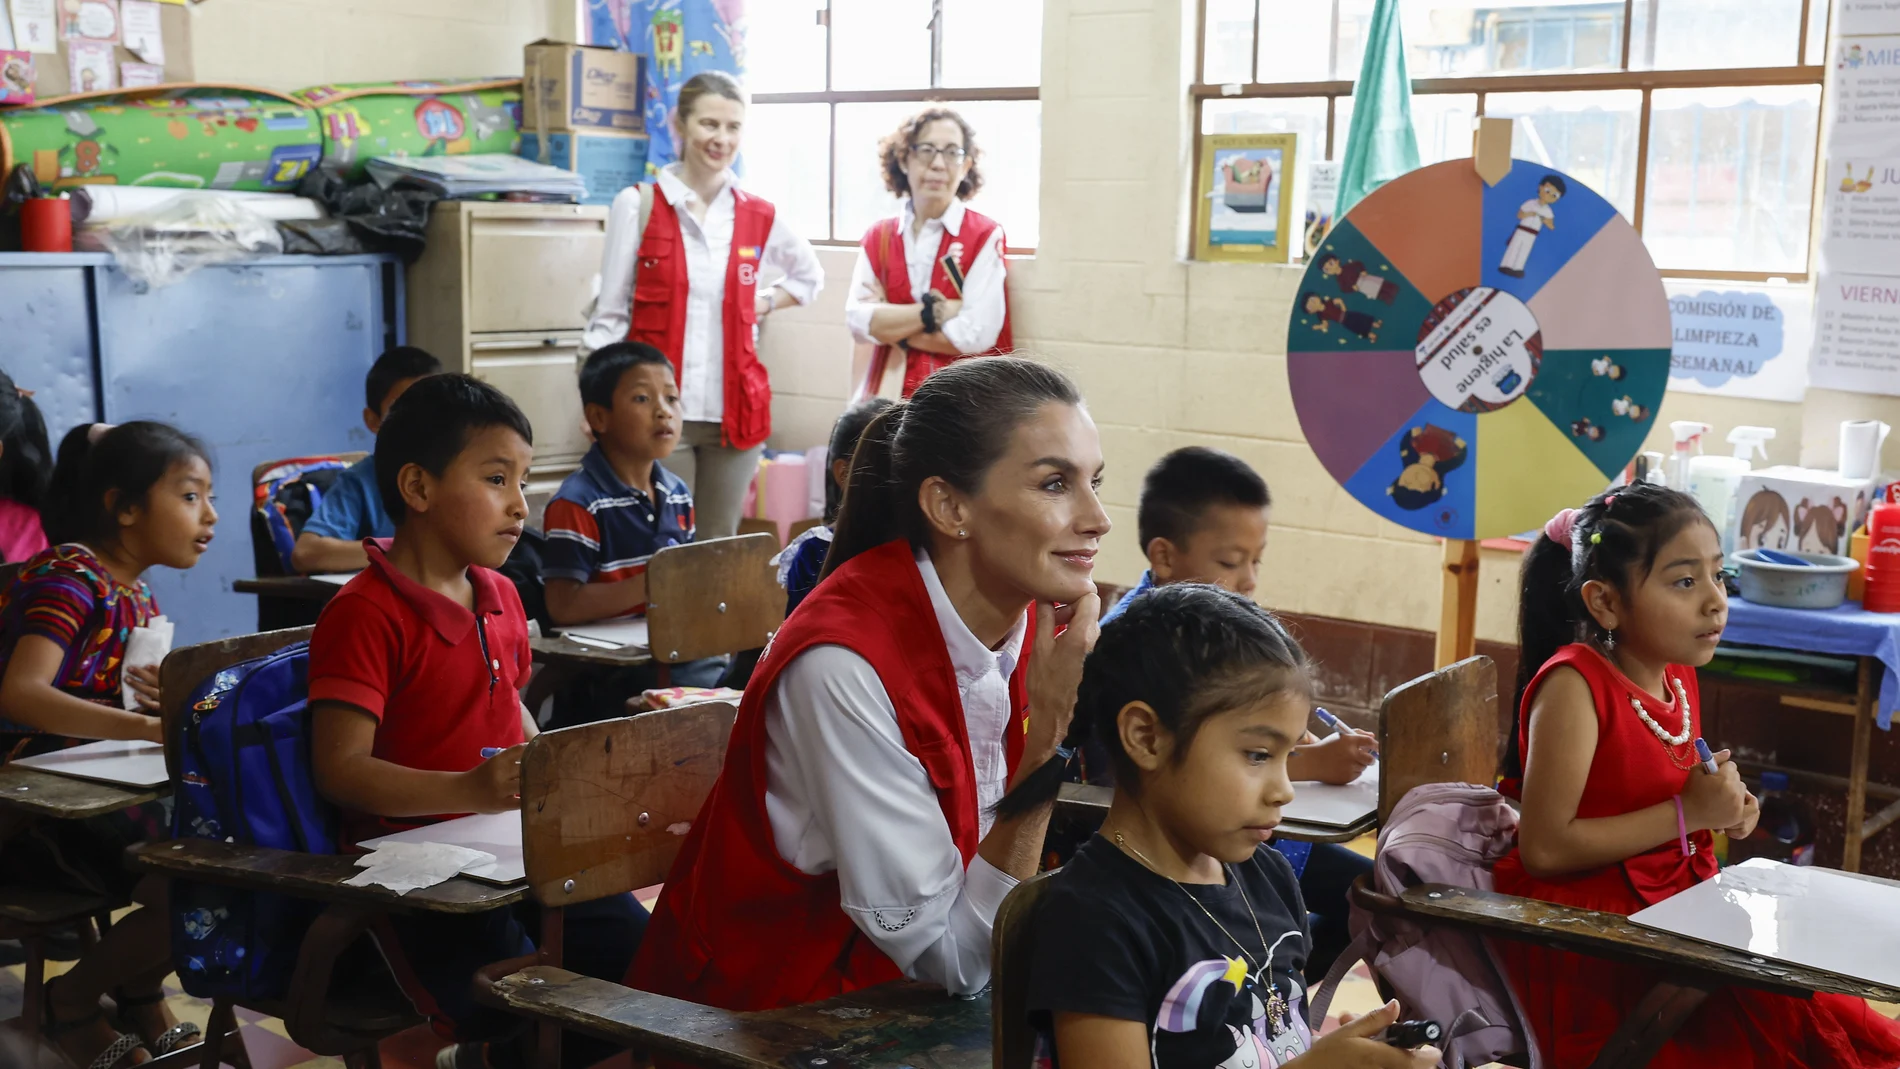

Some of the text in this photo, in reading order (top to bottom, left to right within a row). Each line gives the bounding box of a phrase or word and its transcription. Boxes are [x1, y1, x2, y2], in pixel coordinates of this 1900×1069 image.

[1840, 284, 1900, 304] VIERN
[1752, 304, 1776, 321] DE
[1475, 316, 1492, 333] es
[1502, 329, 1524, 348] La
[1674, 328, 1760, 348] LIMPIEZA
[1440, 331, 1477, 371] salud
[1455, 345, 1508, 394] higiene
[1670, 354, 1758, 374] SEMANAL
